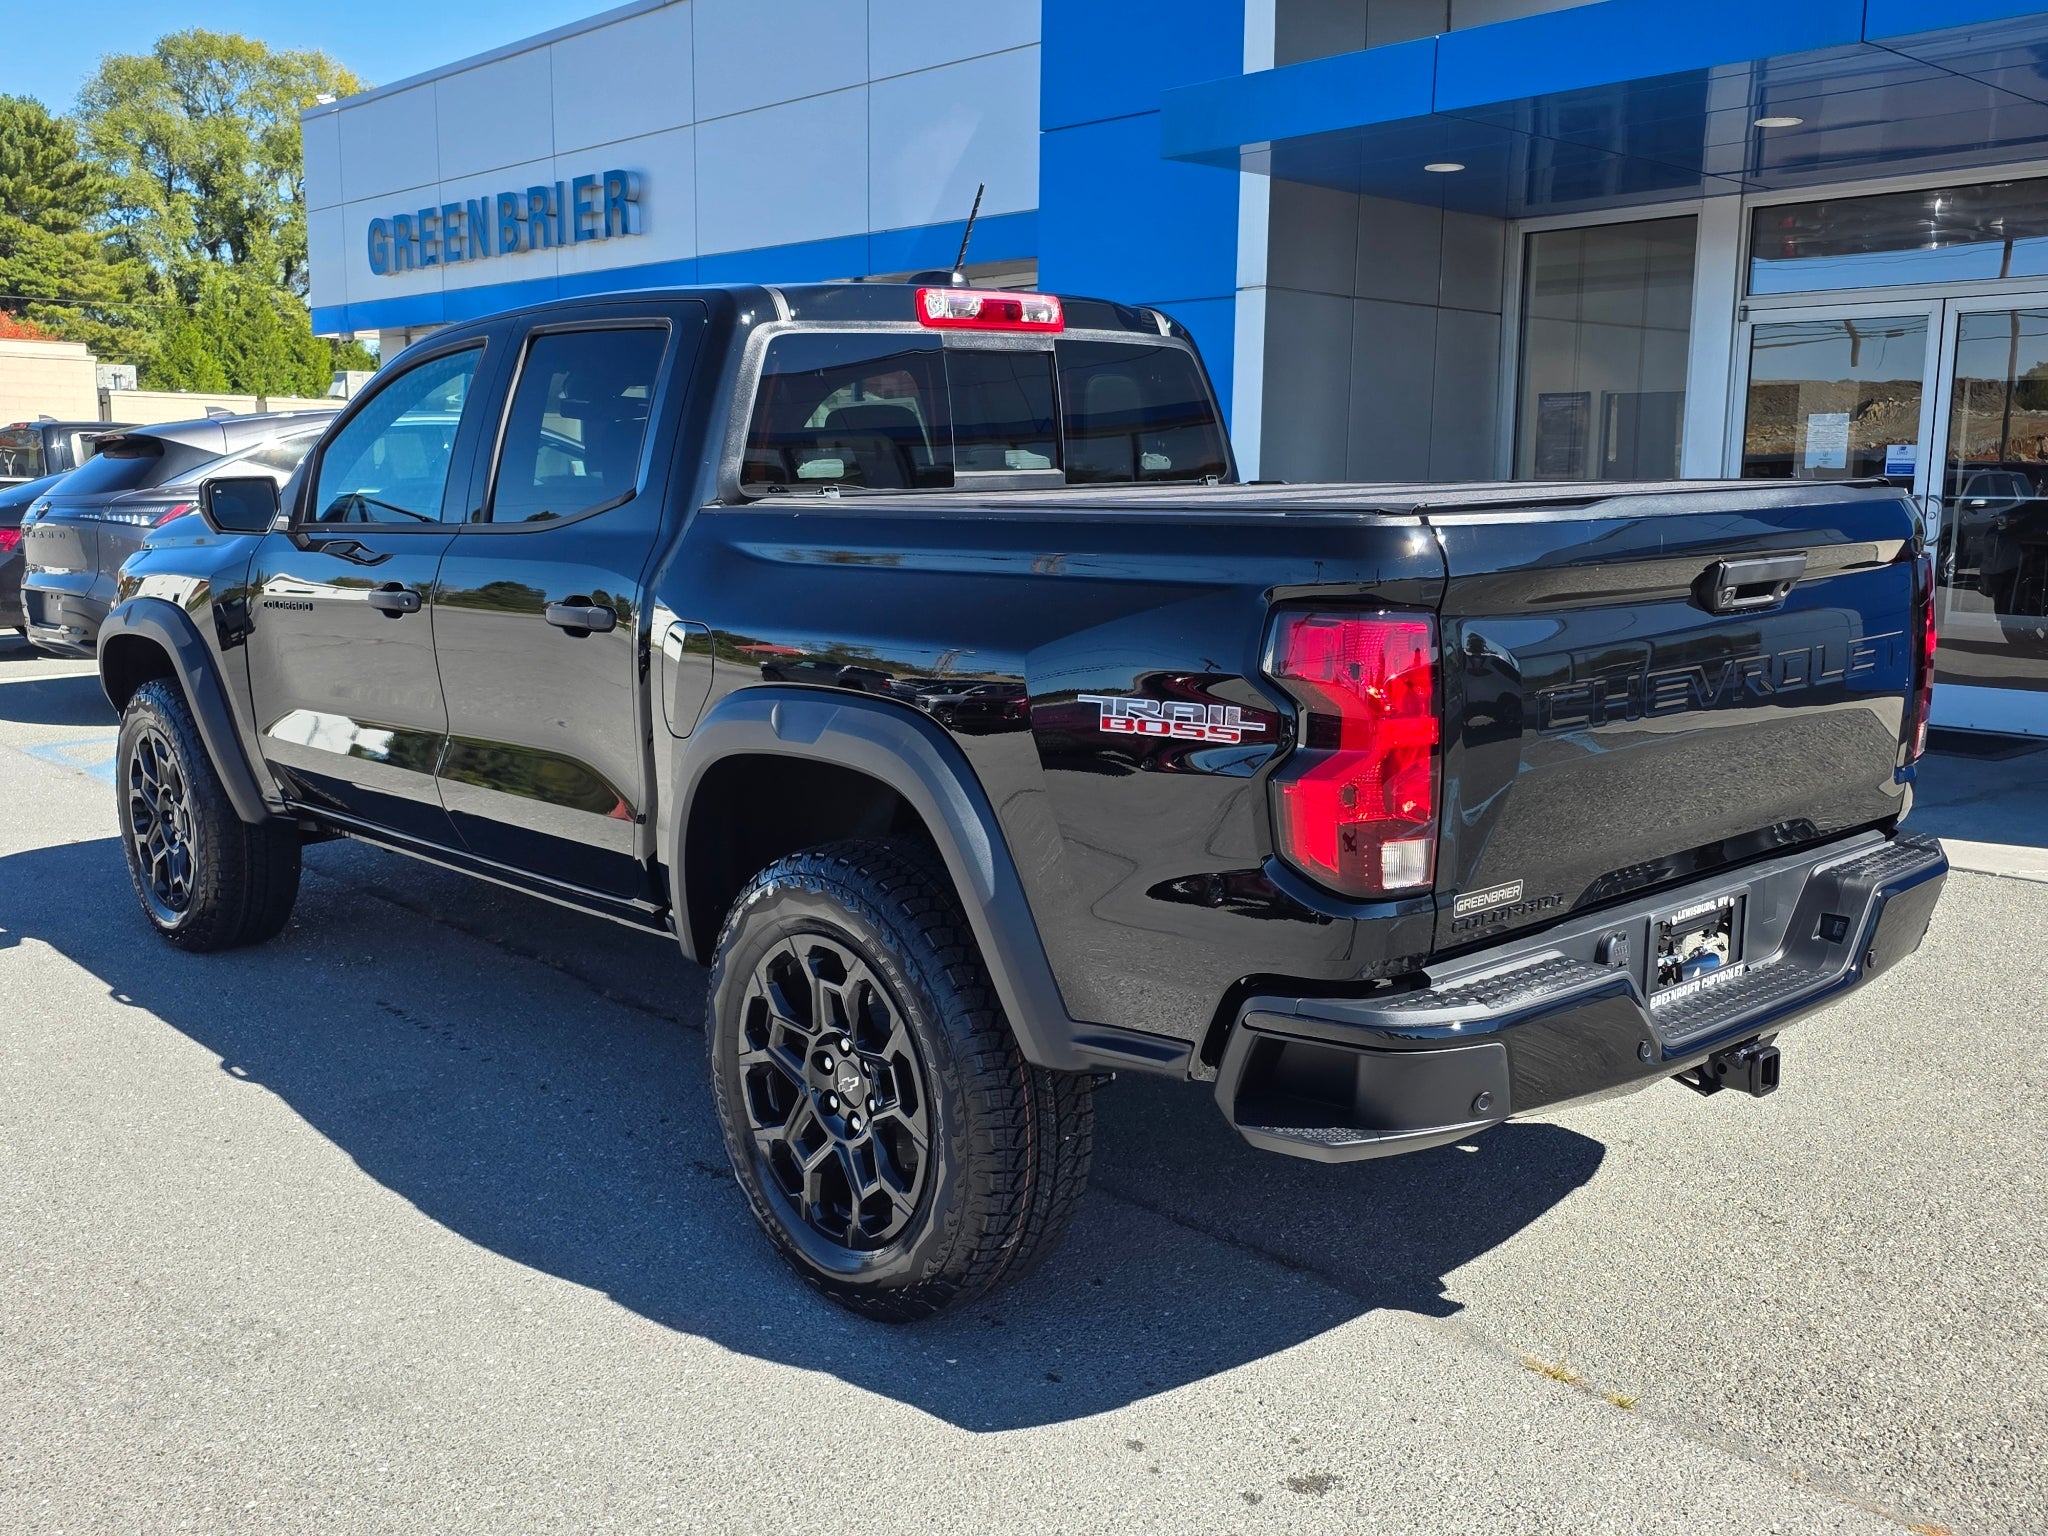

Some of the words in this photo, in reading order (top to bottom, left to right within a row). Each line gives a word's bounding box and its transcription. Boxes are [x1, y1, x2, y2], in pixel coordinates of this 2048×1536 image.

[368, 169, 642, 276] GREENBRIER
[263, 600, 314, 612] COLORADO
[1535, 630, 1905, 737] CHEVROLET
[1078, 694, 1266, 732] TRAIL
[1100, 715, 1241, 744] BOSS
[1456, 885, 1521, 912] GREENBRIER
[1677, 899, 1717, 921] LEWISBURG,
[1717, 896, 1729, 908] WV
[1650, 981, 1701, 1010] GREENBRIER
[1701, 964, 1745, 989] CHEVROLET
